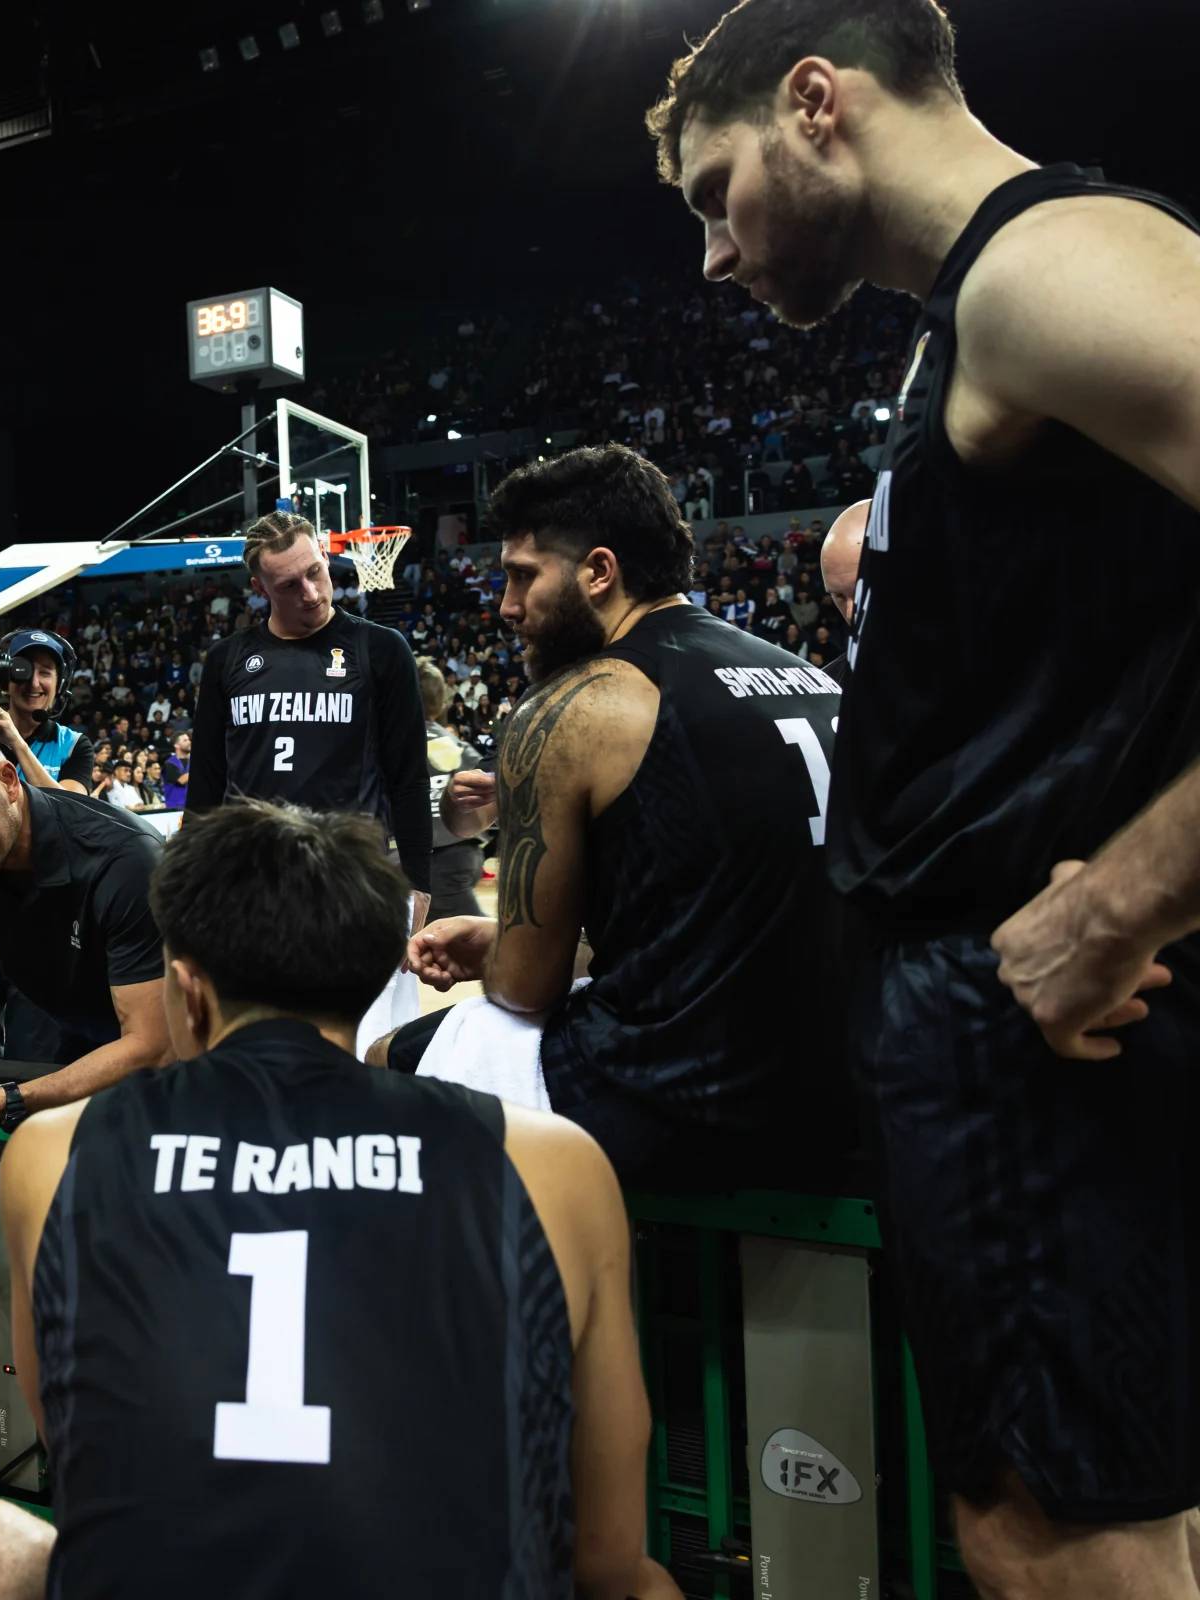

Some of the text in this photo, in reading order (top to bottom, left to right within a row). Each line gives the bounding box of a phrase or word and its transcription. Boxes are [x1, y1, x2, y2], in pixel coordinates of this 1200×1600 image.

[231, 692, 353, 727] NEW ZEALAND
[274, 736, 295, 771] 2
[150, 1134, 423, 1194] TE RANGI
[213, 1230, 331, 1464] 1
[760, 1554, 771, 1588] Power
